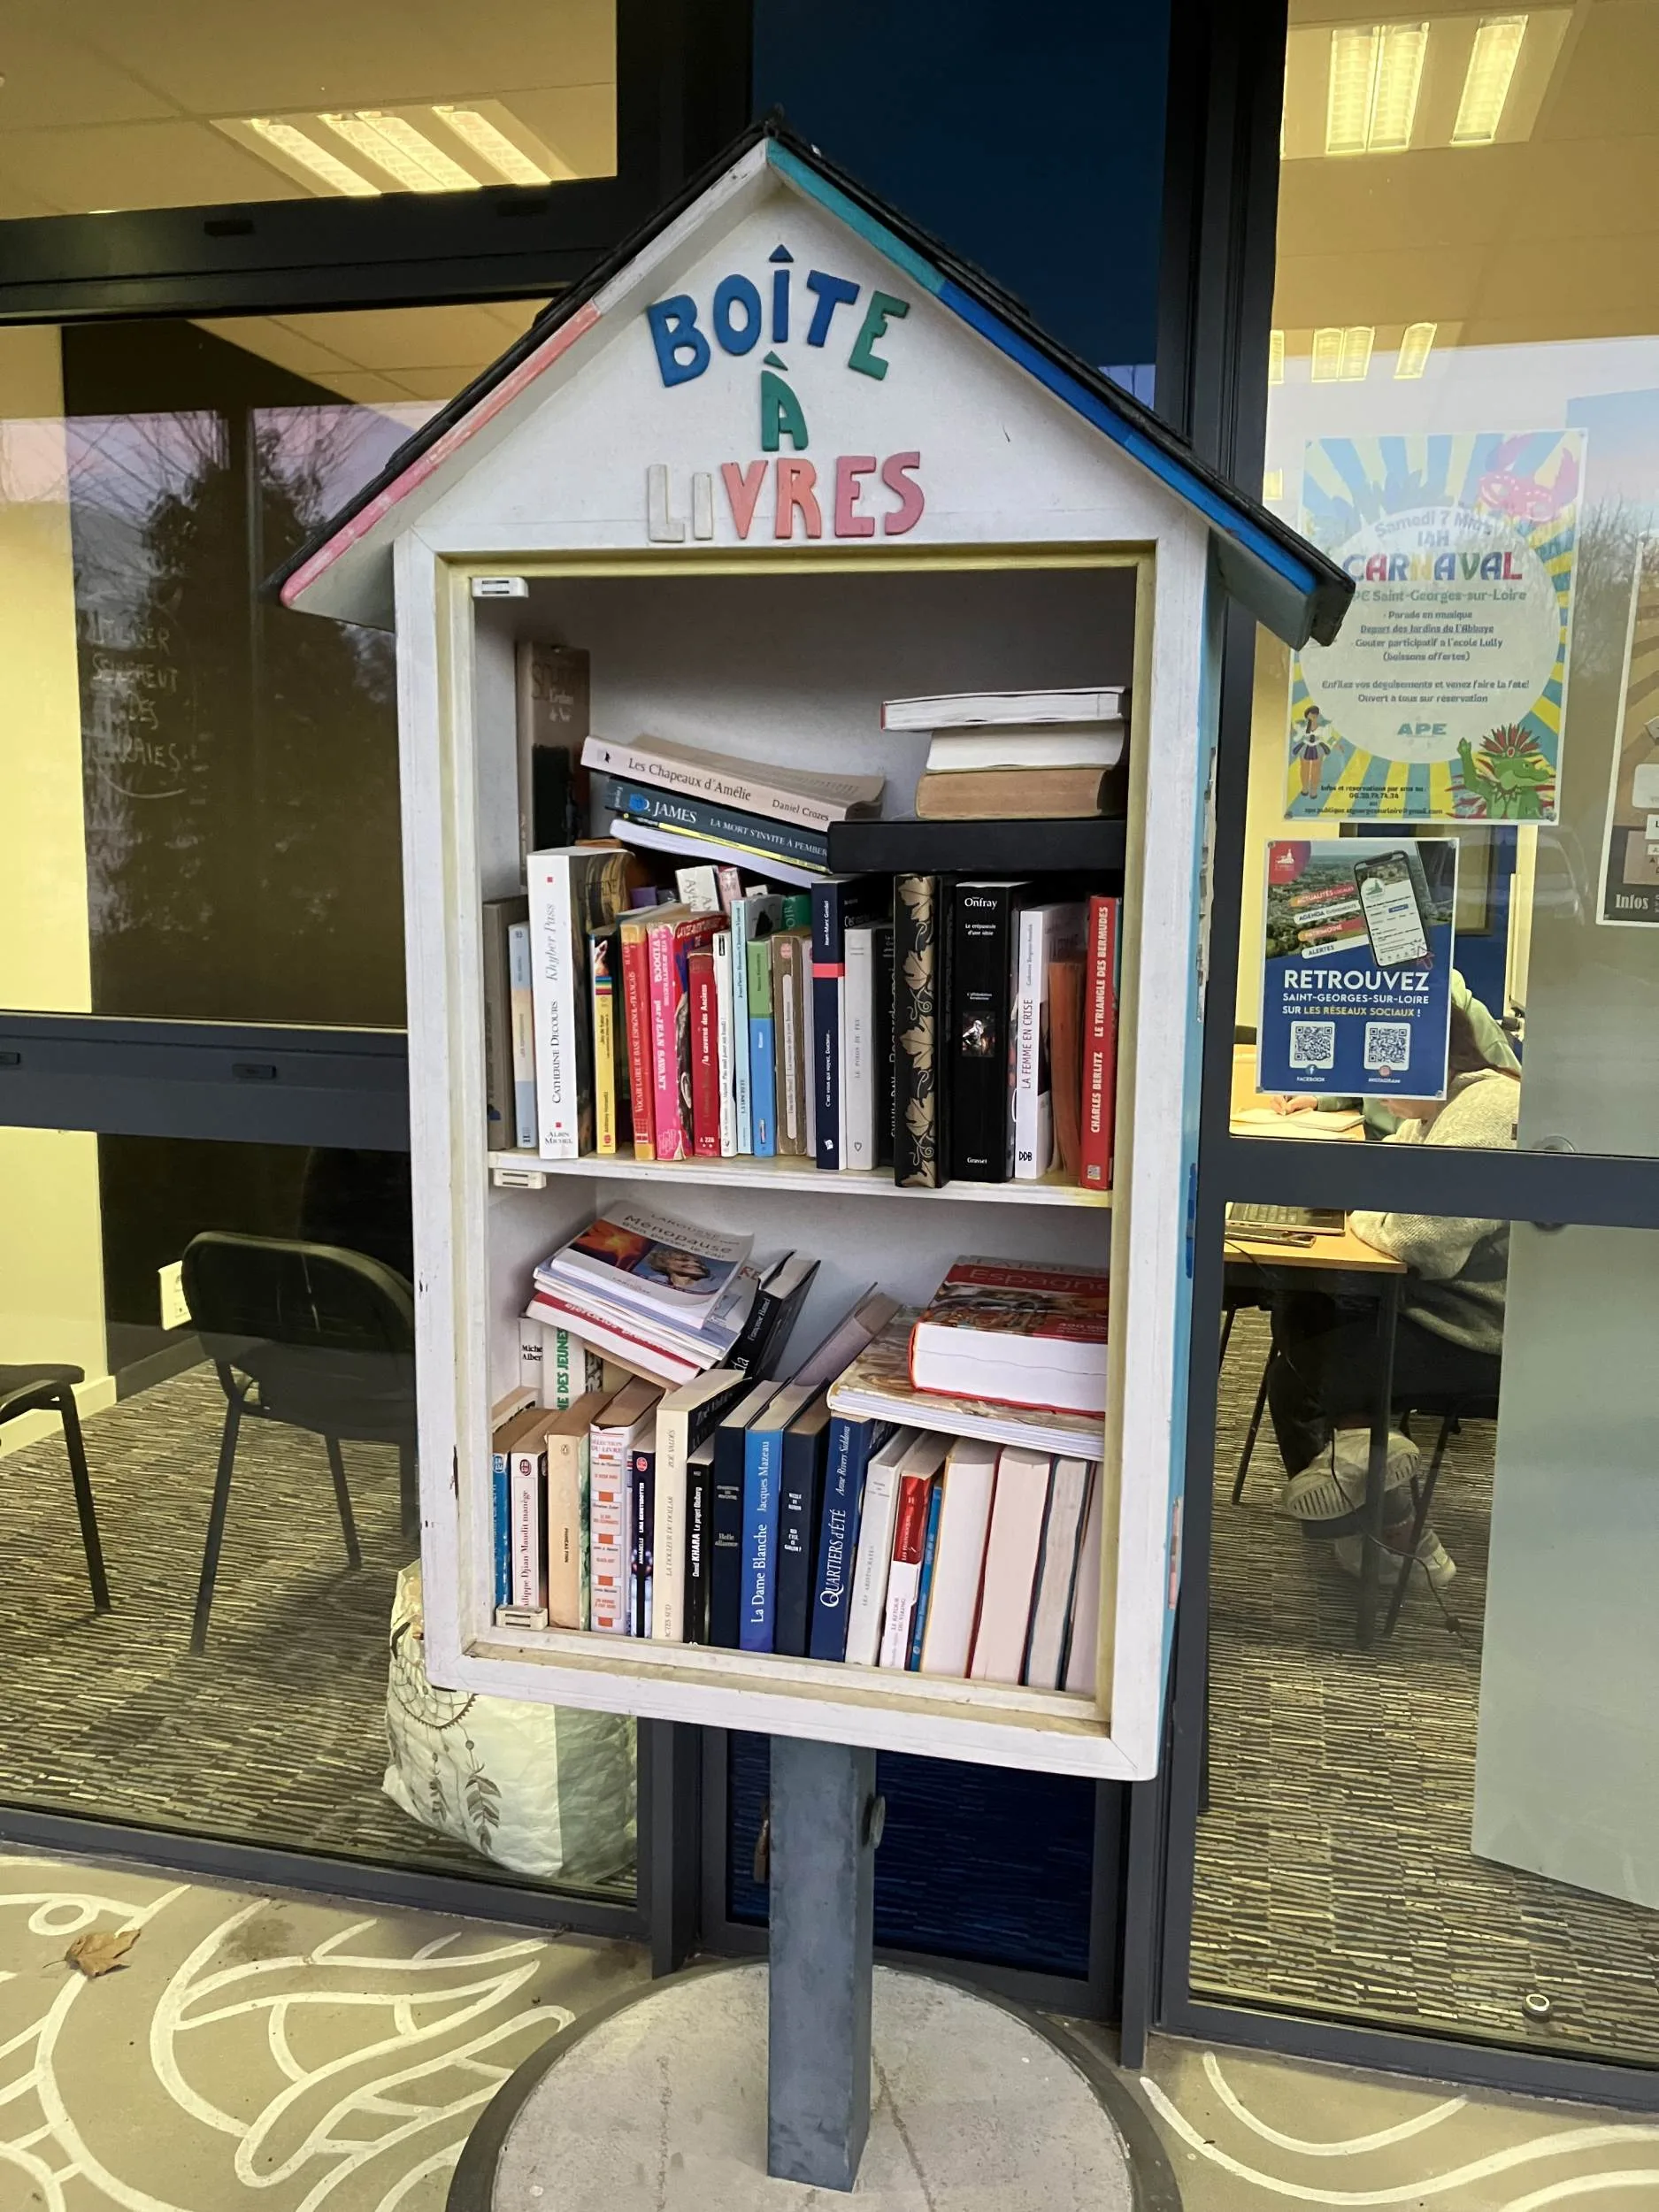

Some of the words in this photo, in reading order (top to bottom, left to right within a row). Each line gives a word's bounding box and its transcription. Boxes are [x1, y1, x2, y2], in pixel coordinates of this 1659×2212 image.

[648, 243, 910, 388] BOÎTE
[761, 350, 809, 452] À
[647, 451, 926, 542] LIVRES
[1374, 511, 1437, 538] Samedi
[1441, 510, 1450, 527] 7
[1341, 552, 1523, 581] CARNAVAL
[1373, 588, 1527, 604] Saint-Georges-sur-Loire
[1397, 723, 1448, 736] APE
[627, 757, 646, 772] Les
[649, 763, 702, 791] Chapeaux
[703, 775, 752, 802] d'Amélie
[772, 798, 800, 814] Daniel
[802, 806, 830, 823] Crozes
[653, 801, 697, 825] JAMES
[710, 817, 722, 830] LA
[723, 820, 748, 835] MORT
[749, 826, 786, 847] S'INVITE
[964, 897, 998, 910] Onfray
[1615, 893, 1649, 910] Infos
[545, 903, 557, 935] Pass
[1096, 906, 1109, 957] BERMUDES
[545, 937, 558, 982] Khyber
[653, 939, 663, 983] VIDOCQ
[1308, 944, 1335, 956] ALERTES
[1095, 959, 1106, 977] DES
[1284, 969, 1430, 992] RETROUVEZ
[1022, 999, 1033, 1025] CRISE
[1094, 979, 1105, 1024] TRIANGLE
[1282, 992, 1430, 1005] SAINT-GEORGES-SUR-LOIRE
[1282, 1005, 1302, 1015] SUR
[1303, 1006, 1321, 1015] LES
[1323, 1004, 1367, 1016] RÉSEAUX
[1371, 1007, 1415, 1018] SOCIAUX
[549, 1000, 560, 1046] DECOURS
[657, 1017, 665, 1046] JEAN
[1022, 1028, 1033, 1041] EN
[1094, 1026, 1104, 1037] LE
[631, 1040, 641, 1056] BASE
[701, 1026, 710, 1054] caverne
[632, 1057, 641, 1066] DE
[657, 1049, 667, 1091] SAVANT
[1021, 1043, 1033, 1075] FEMME
[1091, 1051, 1103, 1090] BERLITZ
[551, 1047, 563, 1103] CATHERINE
[1021, 1078, 1032, 1089] LA
[632, 1067, 644, 1113] VOCABULAIRE
[1090, 1093, 1102, 1133] CHARLES
[1018, 1150, 1033, 1162] DDB
[557, 1371, 569, 1394] DES
[838, 1425, 850, 1453] Siddons
[757, 1441, 770, 1476] Mazeau
[836, 1454, 848, 1476] Rivers
[757, 1478, 769, 1512] Jacques
[834, 1476, 846, 1496] Anne
[520, 1523, 530, 1554] Maudit
[828, 1509, 846, 1540] d'ÉTÉ
[691, 1533, 701, 1562] KHARA
[752, 1524, 767, 1569] Blanche
[519, 1555, 530, 1578] Djian
[819, 1539, 844, 1608] QUARTIERS
[519, 1579, 531, 1607] ilippe
[751, 1572, 765, 1605] Dame
[750, 1609, 764, 1623] La
